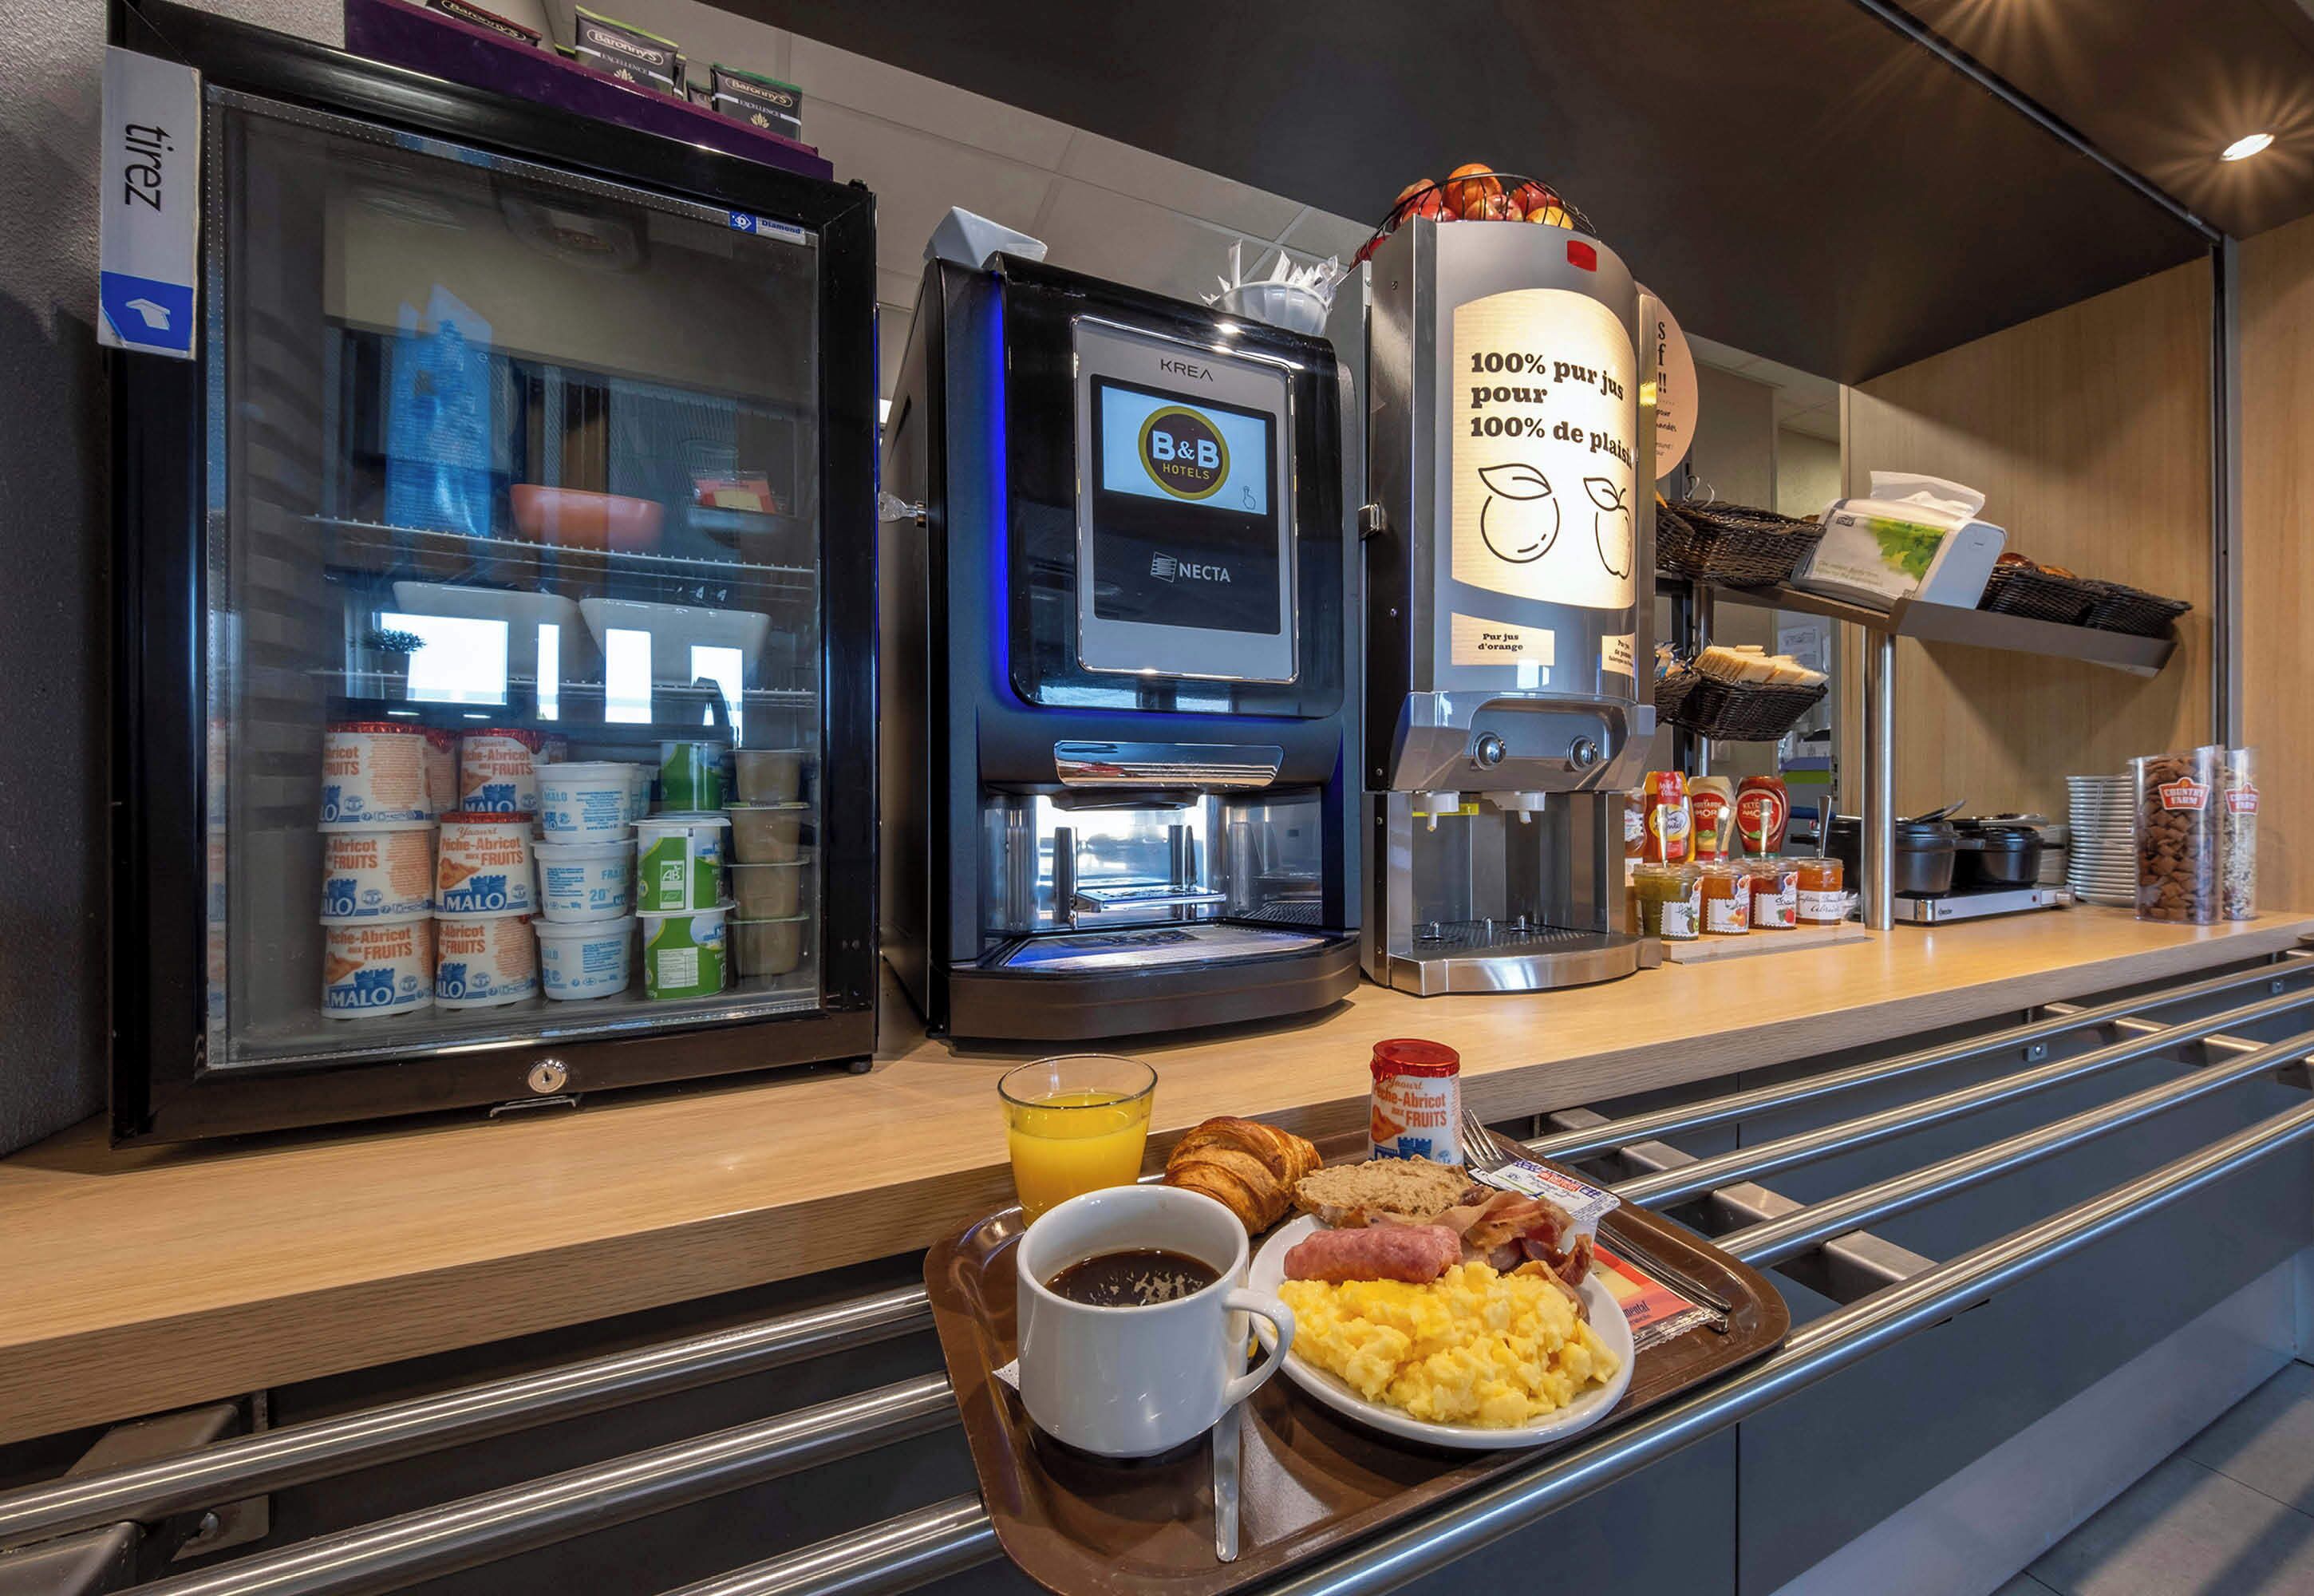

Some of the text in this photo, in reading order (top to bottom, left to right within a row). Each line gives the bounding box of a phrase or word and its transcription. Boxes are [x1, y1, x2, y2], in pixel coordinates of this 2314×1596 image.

[601, 51, 647, 74] EXCELLENCE
[740, 98, 780, 118] EXCELLENCE
[124, 124, 174, 211] tirez
[761, 219, 801, 235] Diamond
[1160, 359, 1214, 382] KREA
[1471, 352, 1624, 401] 100% pur jus
[1471, 386, 1548, 409] pour
[1471, 417, 1545, 438] 100%
[1553, 421, 1584, 443] de
[1153, 431, 1220, 469] B&B
[1163, 463, 1210, 480] HOTELS
[1179, 562, 1231, 583] NECTA
[1478, 642, 1523, 652] d'orange
[1503, 633, 1519, 642] jus
[492, 762, 534, 775] FRUITS
[334, 854, 378, 869] FRUITS
[480, 851, 523, 866] FRUITS
[447, 892, 504, 911] MALO
[363, 942, 413, 960] FRUITS
[445, 940, 486, 954] FRUITS
[330, 986, 393, 1008] MALO
[1405, 1110, 1447, 1128] FRUITS
